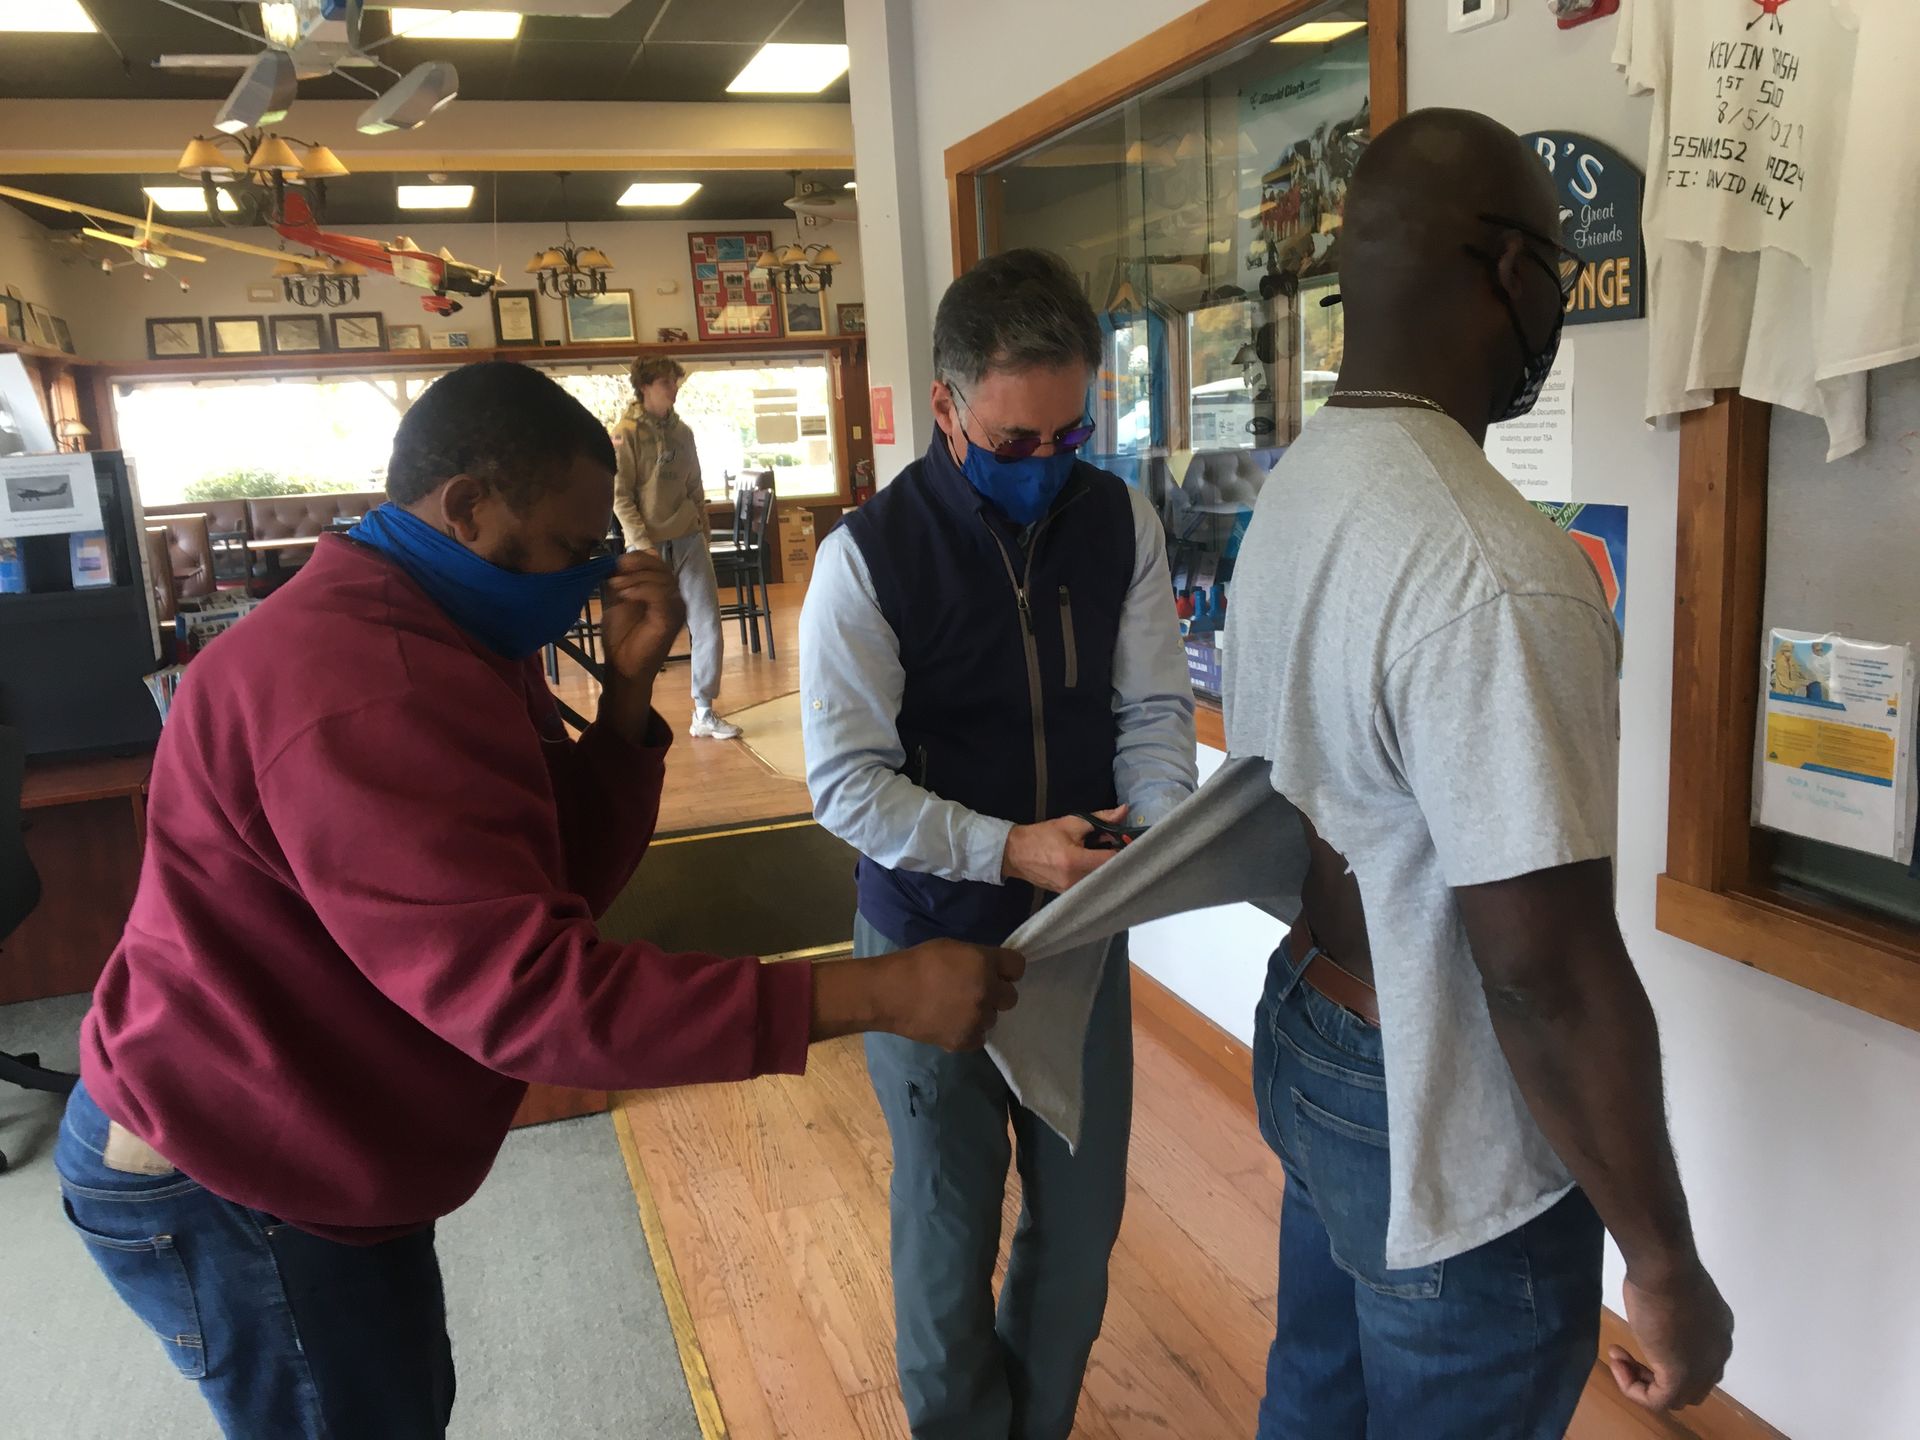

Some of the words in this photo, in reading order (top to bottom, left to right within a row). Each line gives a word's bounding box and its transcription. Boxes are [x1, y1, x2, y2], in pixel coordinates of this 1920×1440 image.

[1708, 41, 1764, 71] KEVIN
[1715, 75, 1744, 99] 1ST
[1580, 202, 1615, 229] Great
[1574, 223, 1624, 249] Friends
[1506, 421, 1539, 430] identification
[1546, 421, 1558, 429] their
[1543, 433, 1553, 441] TSA
[1506, 446, 1544, 455] Representative
[1511, 462, 1527, 470] Thank
